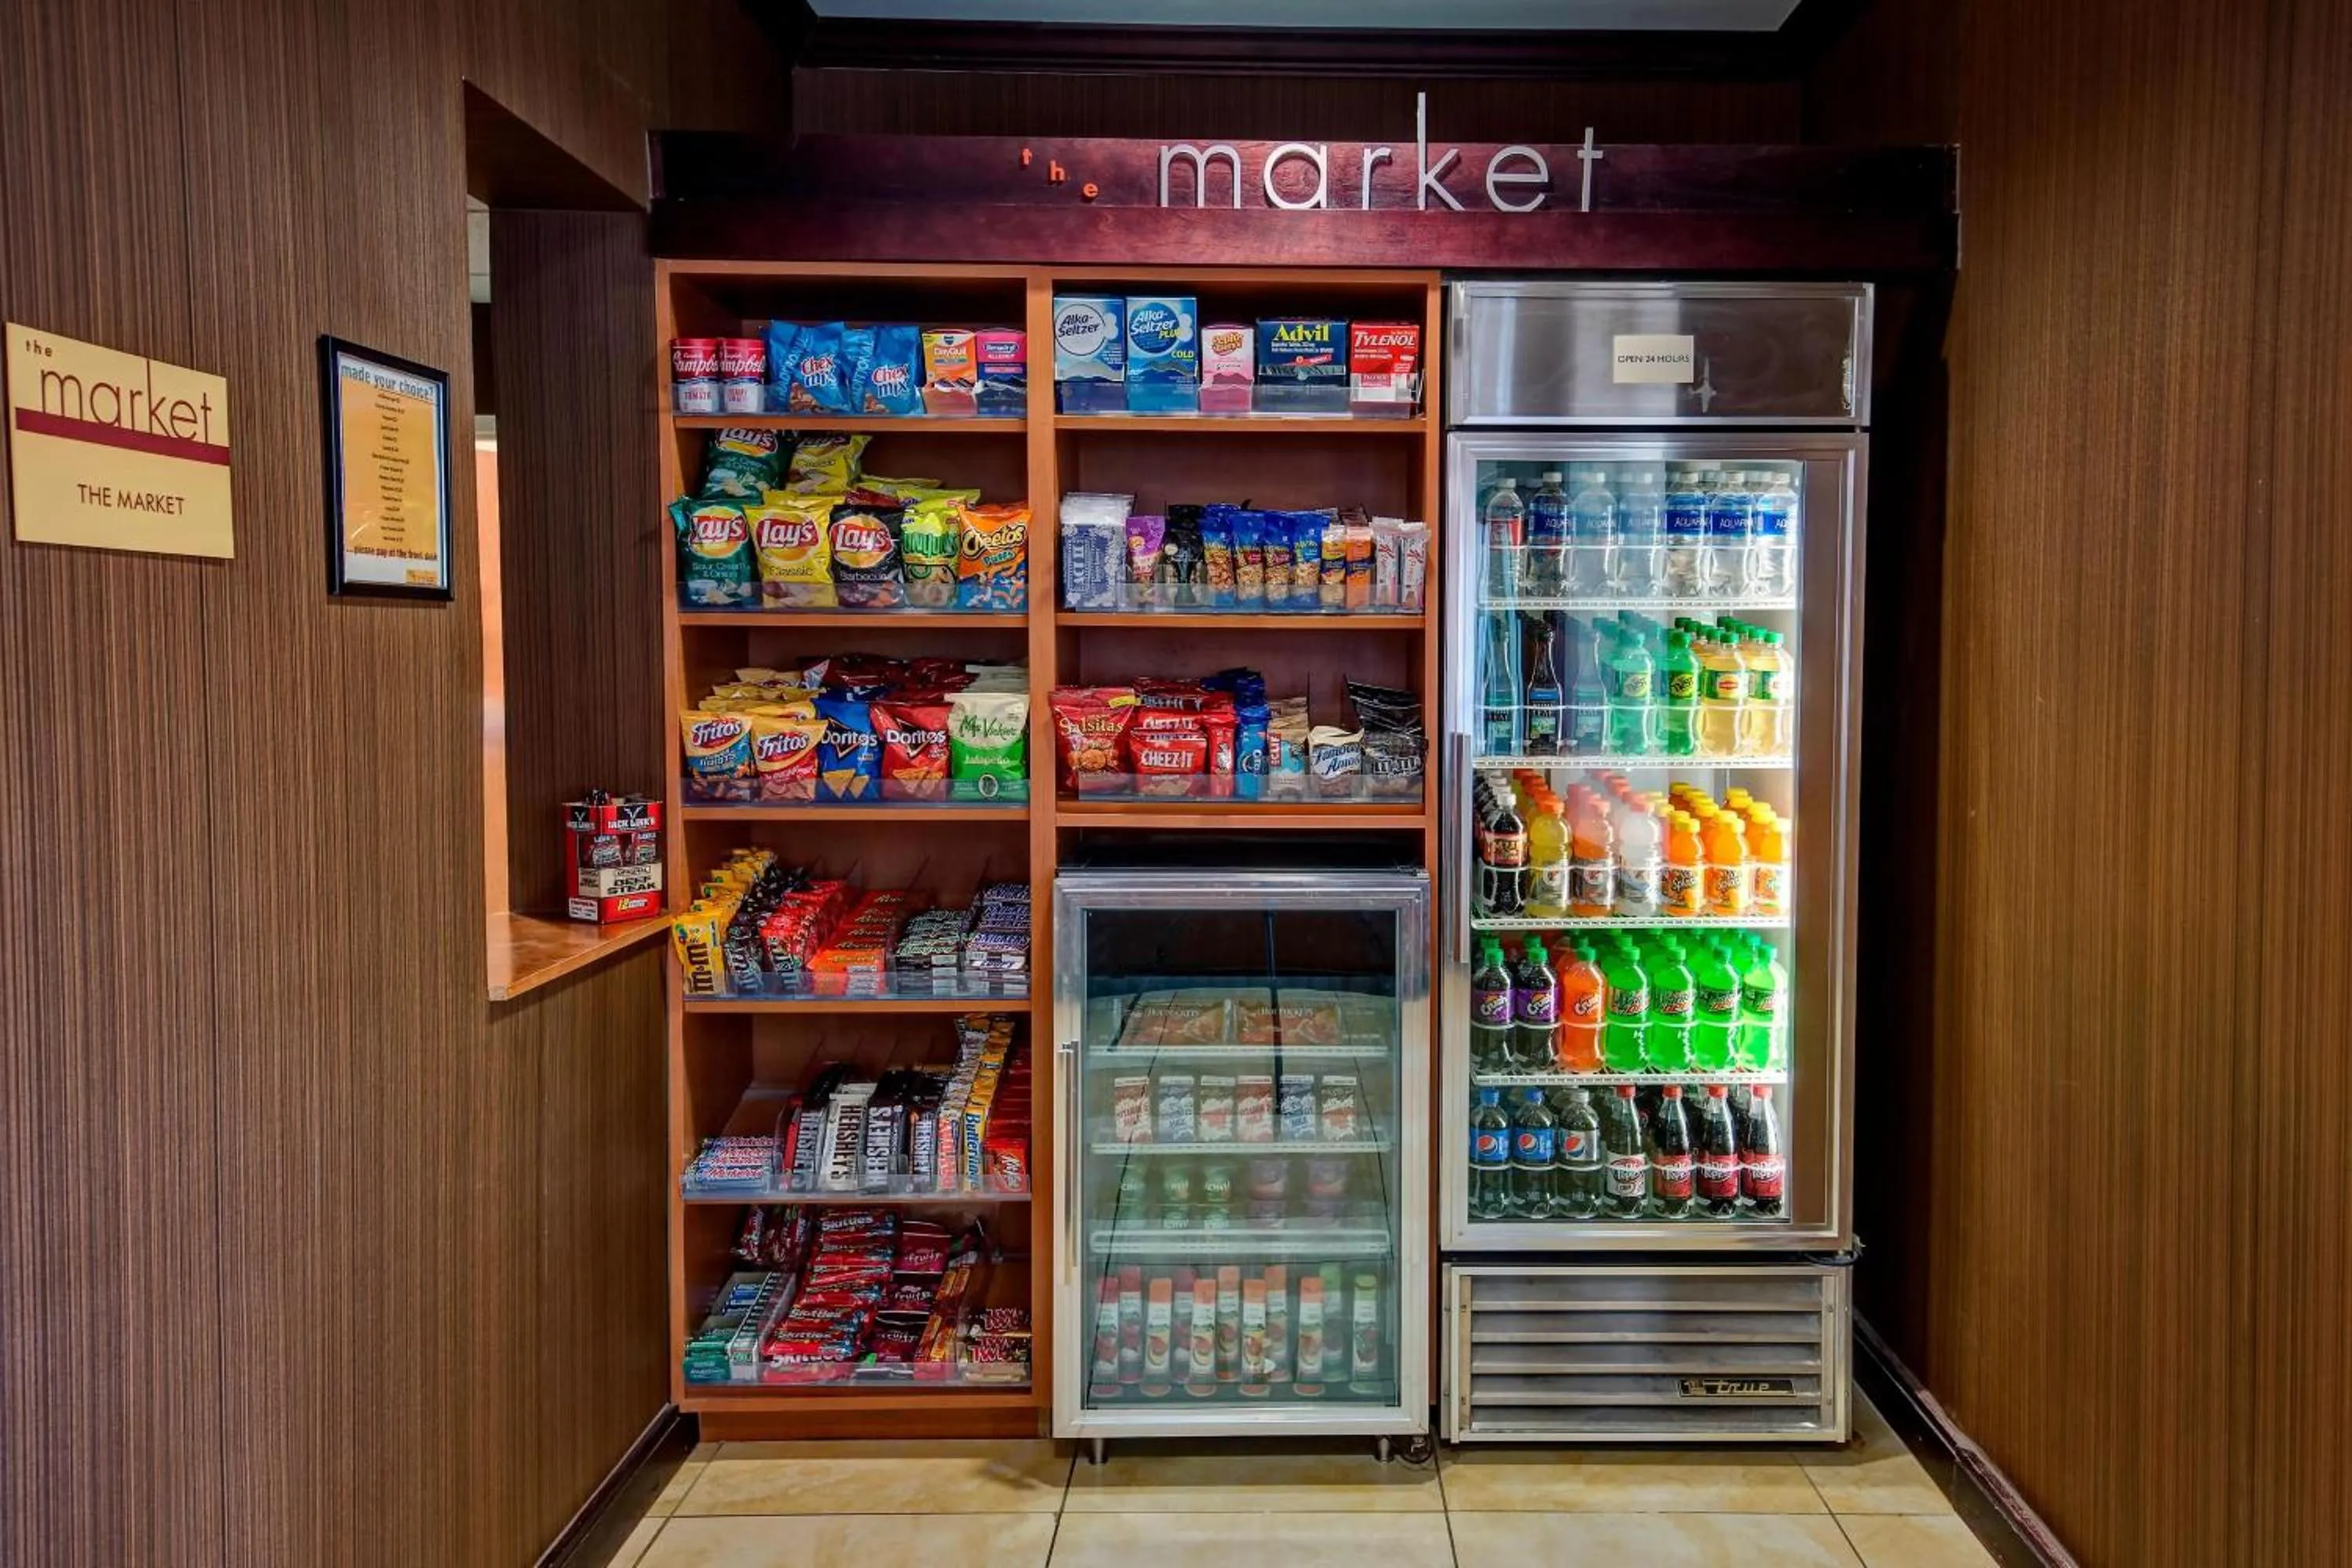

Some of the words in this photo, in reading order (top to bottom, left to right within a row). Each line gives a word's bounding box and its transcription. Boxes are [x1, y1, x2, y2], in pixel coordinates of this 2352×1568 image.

[1021, 149, 1098, 199] the
[1160, 92, 1603, 212] market
[1058, 323, 1099, 337] Seltzer
[1131, 320, 1176, 335] Seltzer
[1272, 323, 1330, 342] Advil
[1354, 331, 1415, 347] TYLENOL
[25, 339, 53, 358] the
[1171, 350, 1195, 359] COLD
[340, 364, 372, 384] made
[374, 374, 397, 390] your
[40, 359, 212, 445] market
[77, 483, 112, 509] THE
[116, 490, 185, 516] MARKET
[694, 514, 746, 543] Lay's
[760, 518, 816, 547] Lay's
[836, 524, 892, 553] Lay's
[961, 524, 1026, 559] Cheetos
[691, 720, 742, 746] Fritos
[886, 728, 946, 745] Doritos
[1059, 717, 1124, 737] Salsitas
[757, 734, 809, 759] Fritos
[830, 1105, 862, 1181] HERSHEY'S
[865, 1105, 892, 1187] HERSHEY'S
